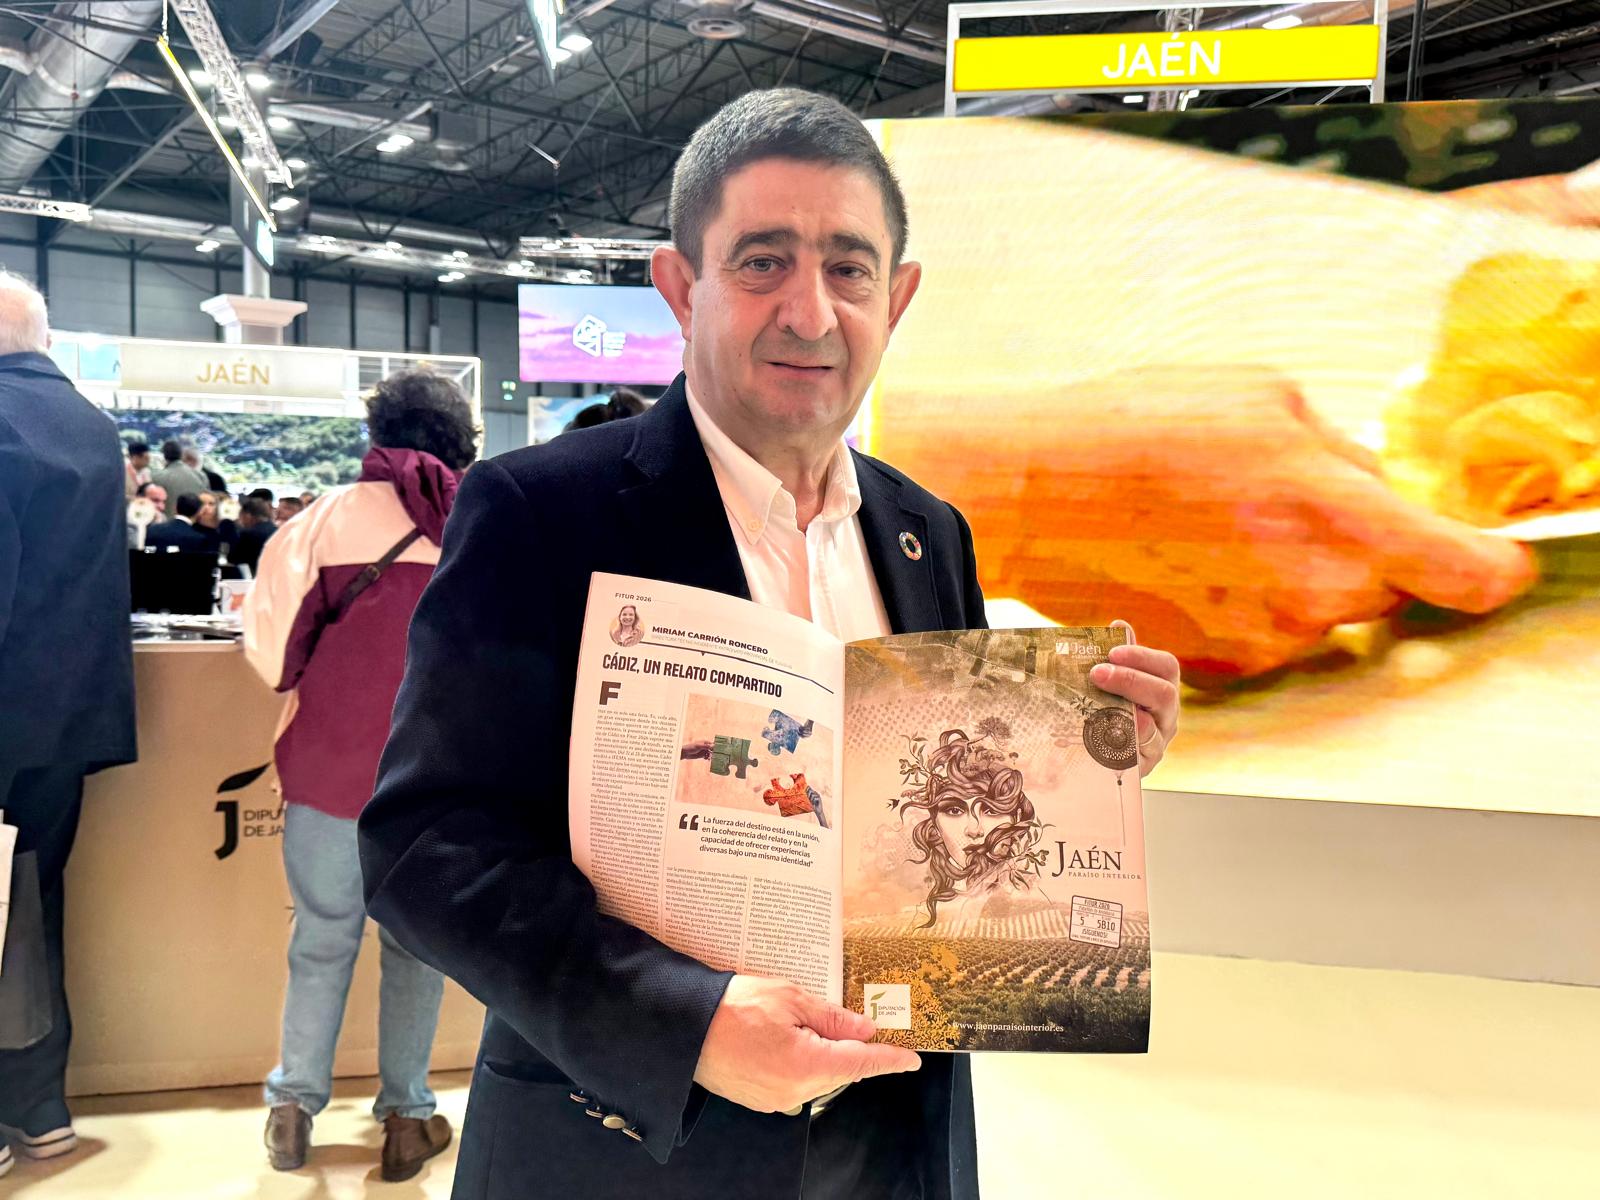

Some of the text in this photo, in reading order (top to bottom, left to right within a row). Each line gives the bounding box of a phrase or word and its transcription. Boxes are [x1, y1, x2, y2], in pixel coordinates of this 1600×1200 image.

[1102, 32, 1222, 79] JAÉN
[196, 357, 271, 385] JAÉN
[615, 592, 634, 600] FITUR
[652, 626, 686, 638] MIRIAM
[687, 631, 727, 645] CARRIÓN
[728, 639, 768, 655] RONCERO
[602, 652, 782, 698] CÁDIZ, UN RELATO COMPARTIDO
[244, 825, 265, 837] DE
[703, 816, 711, 824] La
[712, 817, 734, 827] fuerza
[735, 820, 746, 828] del
[746, 822, 771, 832] destino
[711, 826, 718, 834] la
[719, 828, 756, 840] coherencia
[756, 832, 768, 841] del
[768, 836, 788, 844] relato
[699, 845, 728, 855] diversas
[728, 848, 744, 857] bajo
[758, 853, 780, 862] misma
[700, 836, 735, 846] capacidad
[745, 841, 770, 850] ofrecer
[770, 846, 811, 858] experiencias
[1080, 916, 1116, 931] 5 5B10
[952, 1021, 1065, 1033] www.jaenparaisointerior.es
